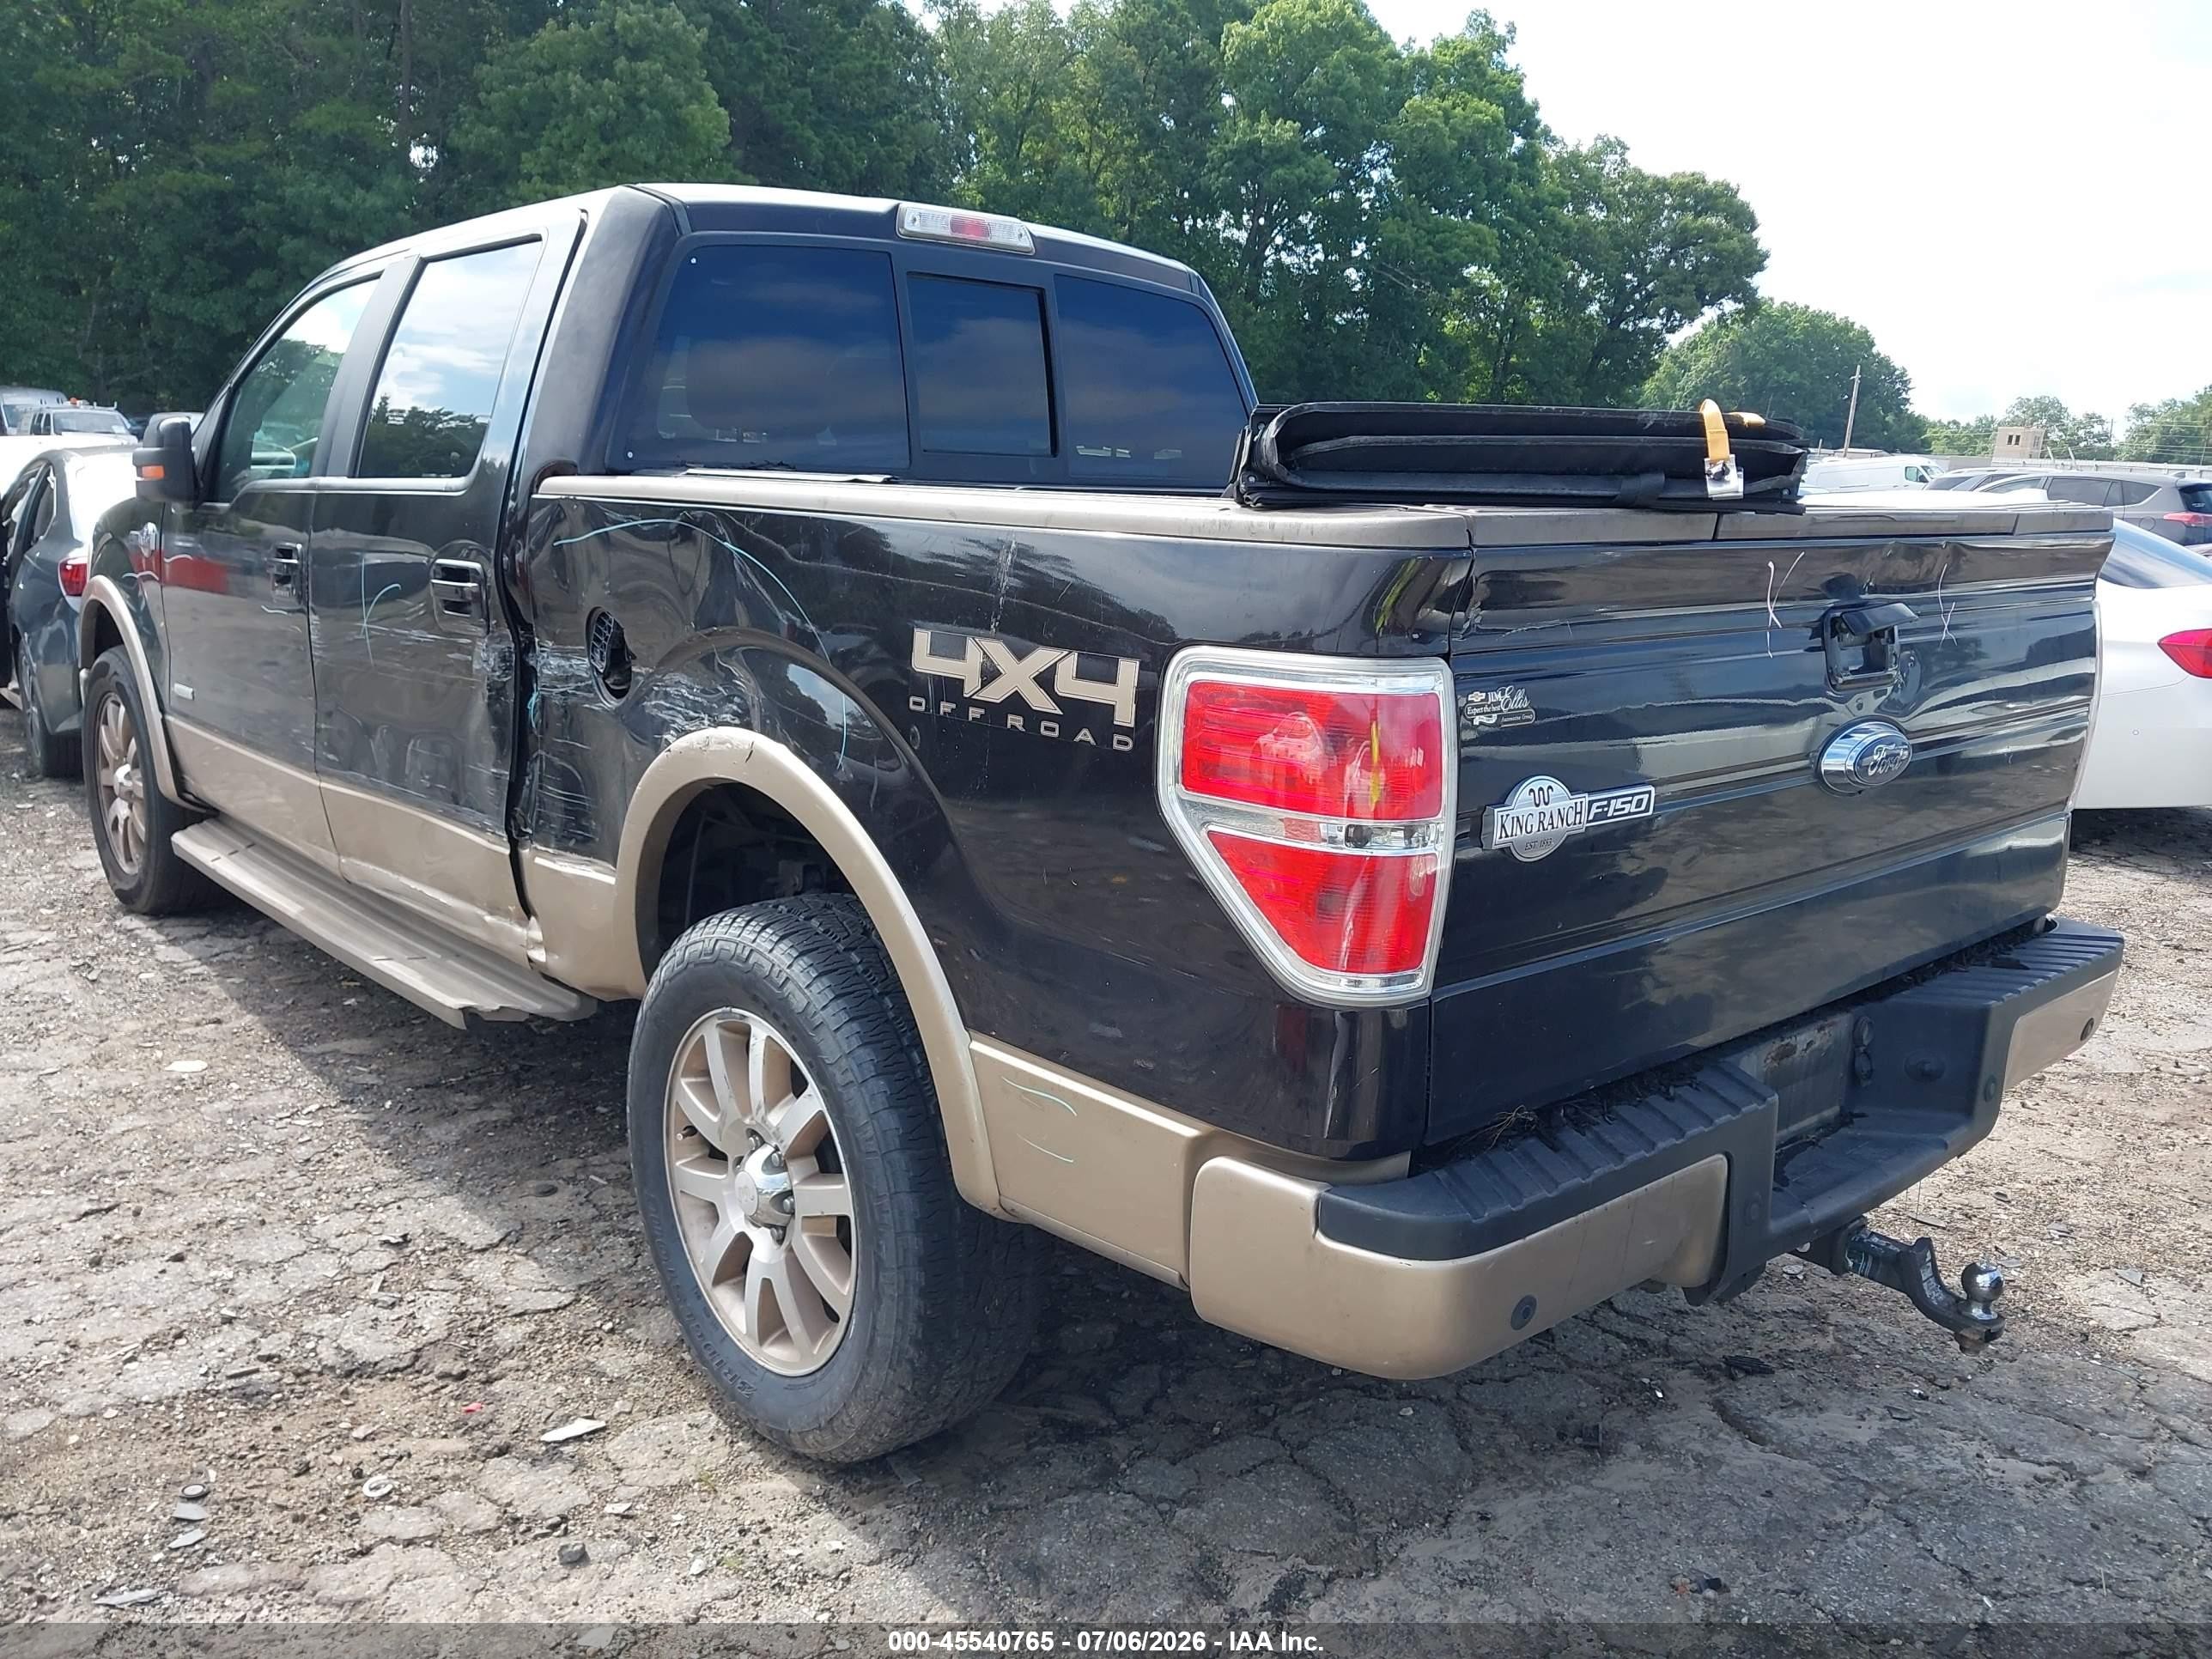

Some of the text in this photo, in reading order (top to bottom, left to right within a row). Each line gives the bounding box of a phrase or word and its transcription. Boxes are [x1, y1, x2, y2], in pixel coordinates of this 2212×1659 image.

[1497, 685, 1531, 712] Ellis
[1006, 714, 1133, 752] ROAD
[1867, 743, 1909, 776] Ford
[1498, 800, 1583, 840] KING RANCH
[1589, 793, 1650, 821] F-150
